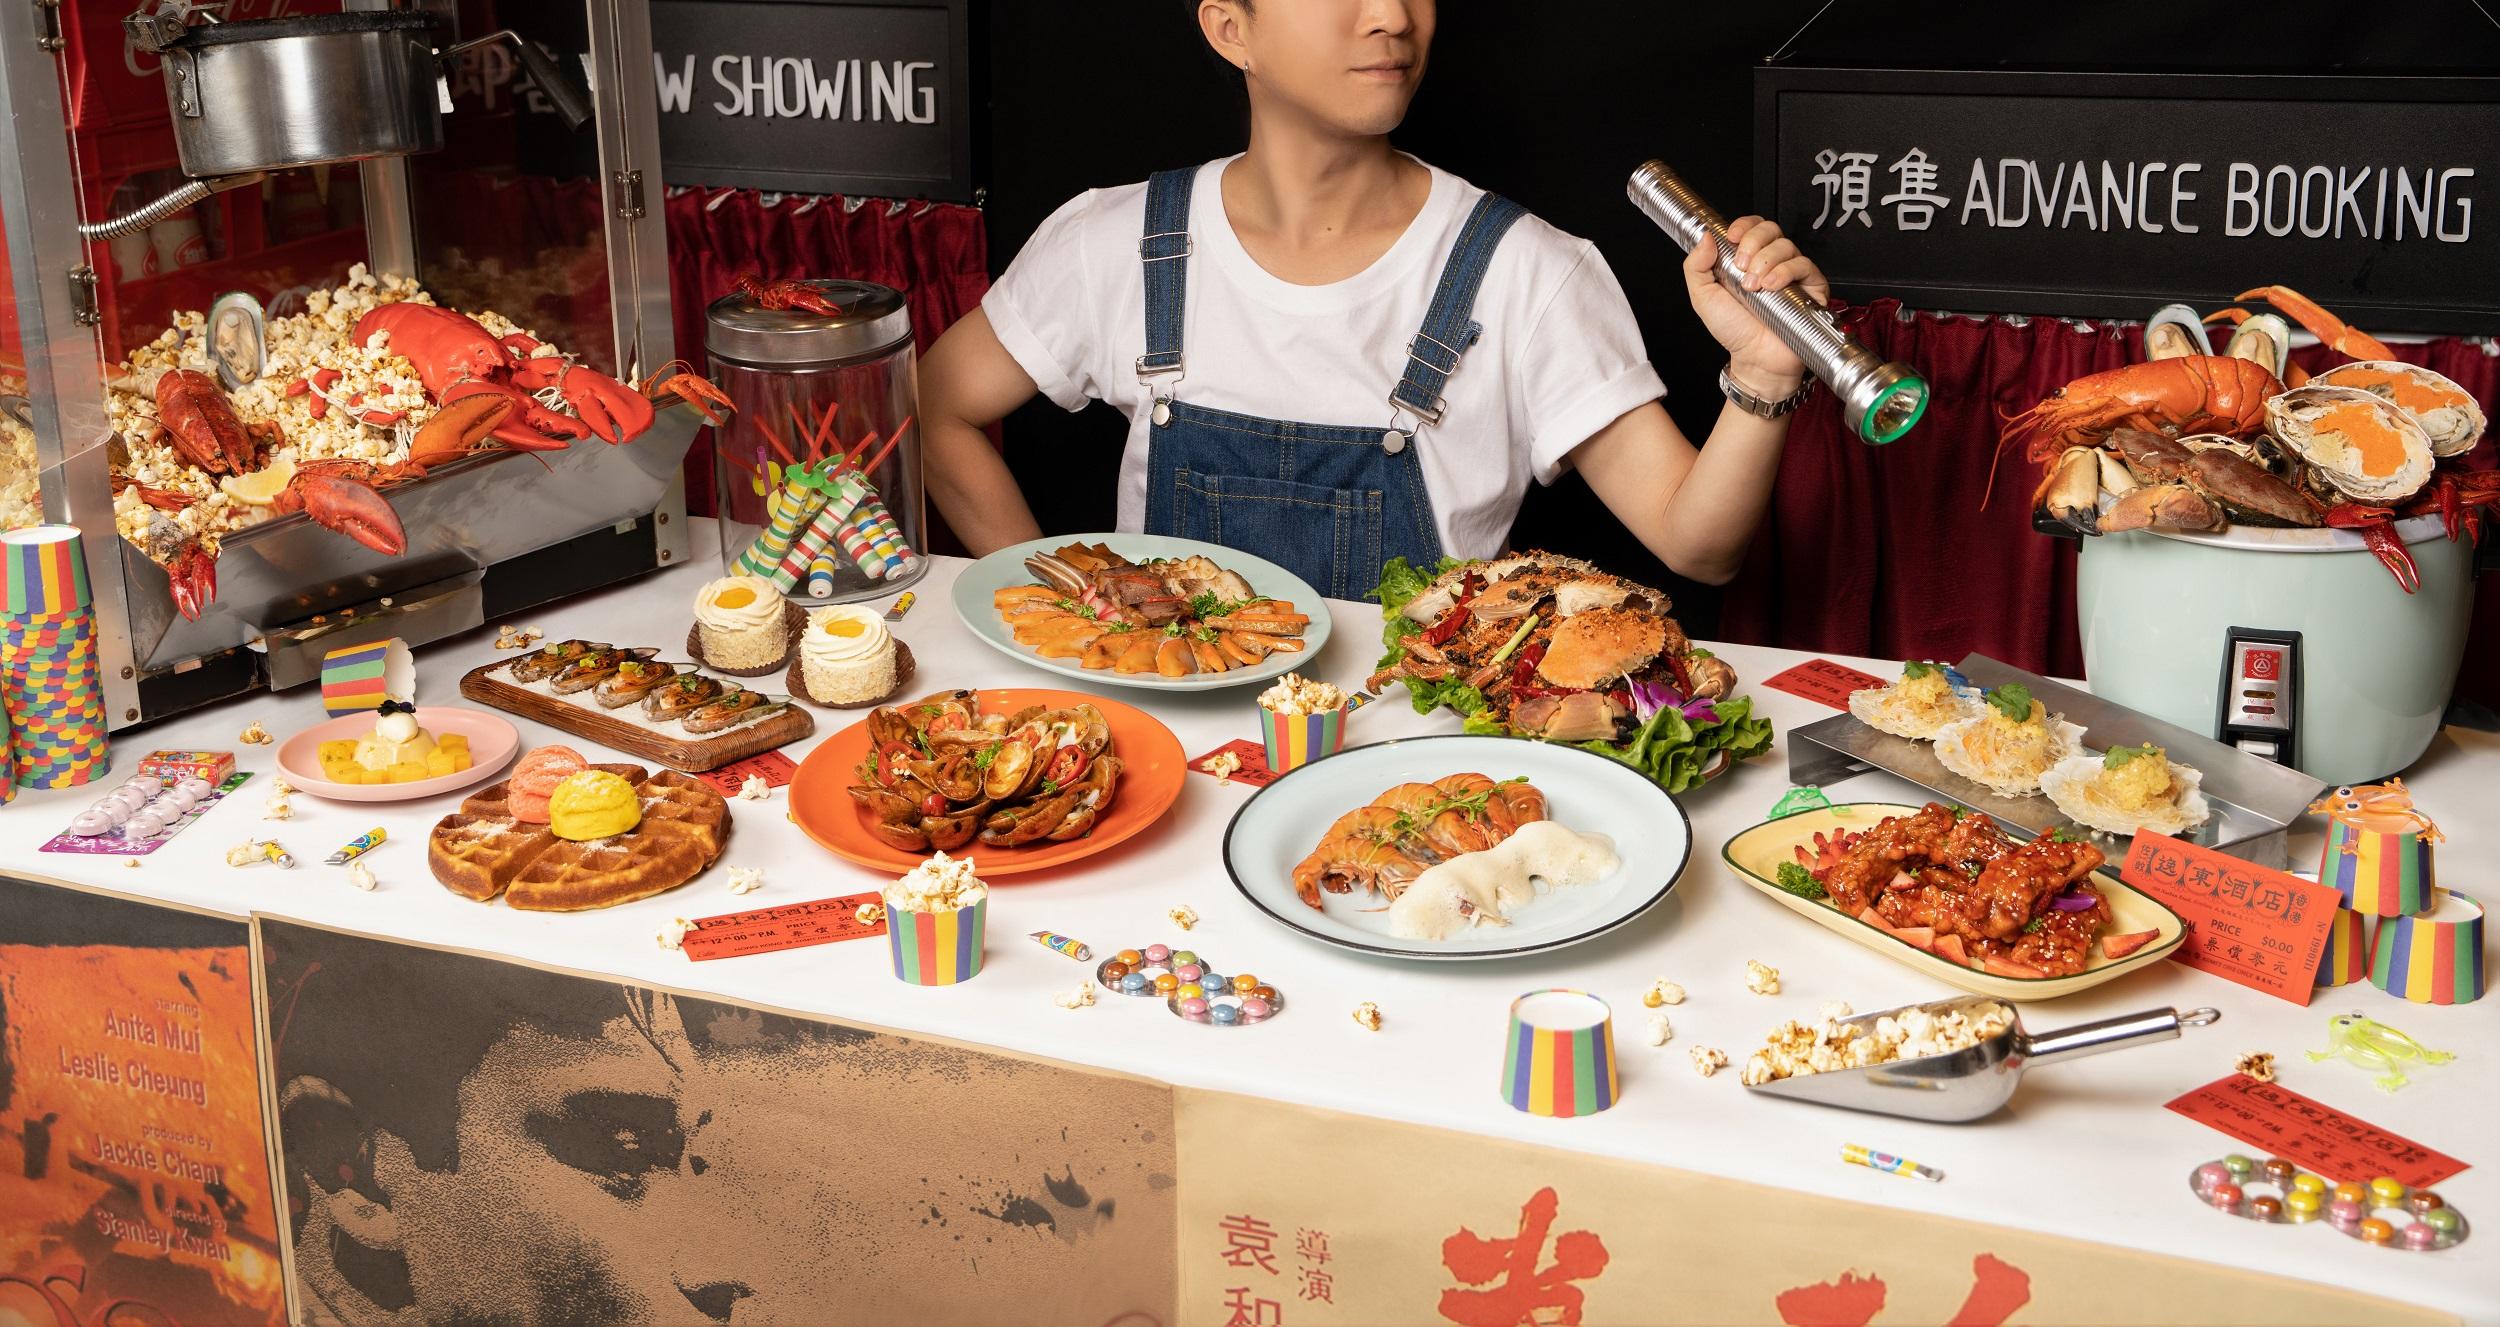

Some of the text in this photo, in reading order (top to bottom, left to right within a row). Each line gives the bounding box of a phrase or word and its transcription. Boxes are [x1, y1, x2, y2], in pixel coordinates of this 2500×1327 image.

[711, 54, 936, 125] SHOWING
[1811, 146, 1951, 232] 預售
[1960, 156, 2476, 243] ADVANCE BOOKING
[2154, 855, 2285, 912] 逸東酒店
[2211, 919, 2241, 937] PRICE
[2261, 936, 2294, 954] $0.00
[105, 1007, 203, 1056] Anita Mui
[156, 998, 199, 1018] starring
[58, 1045, 208, 1109] Leslie Cheung
[92, 1133, 220, 1185] Jackie Chan
[141, 1124, 212, 1152] produced by
[95, 1208, 232, 1262] Stanley Kwan
[1296, 1227, 1334, 1305] 導演
